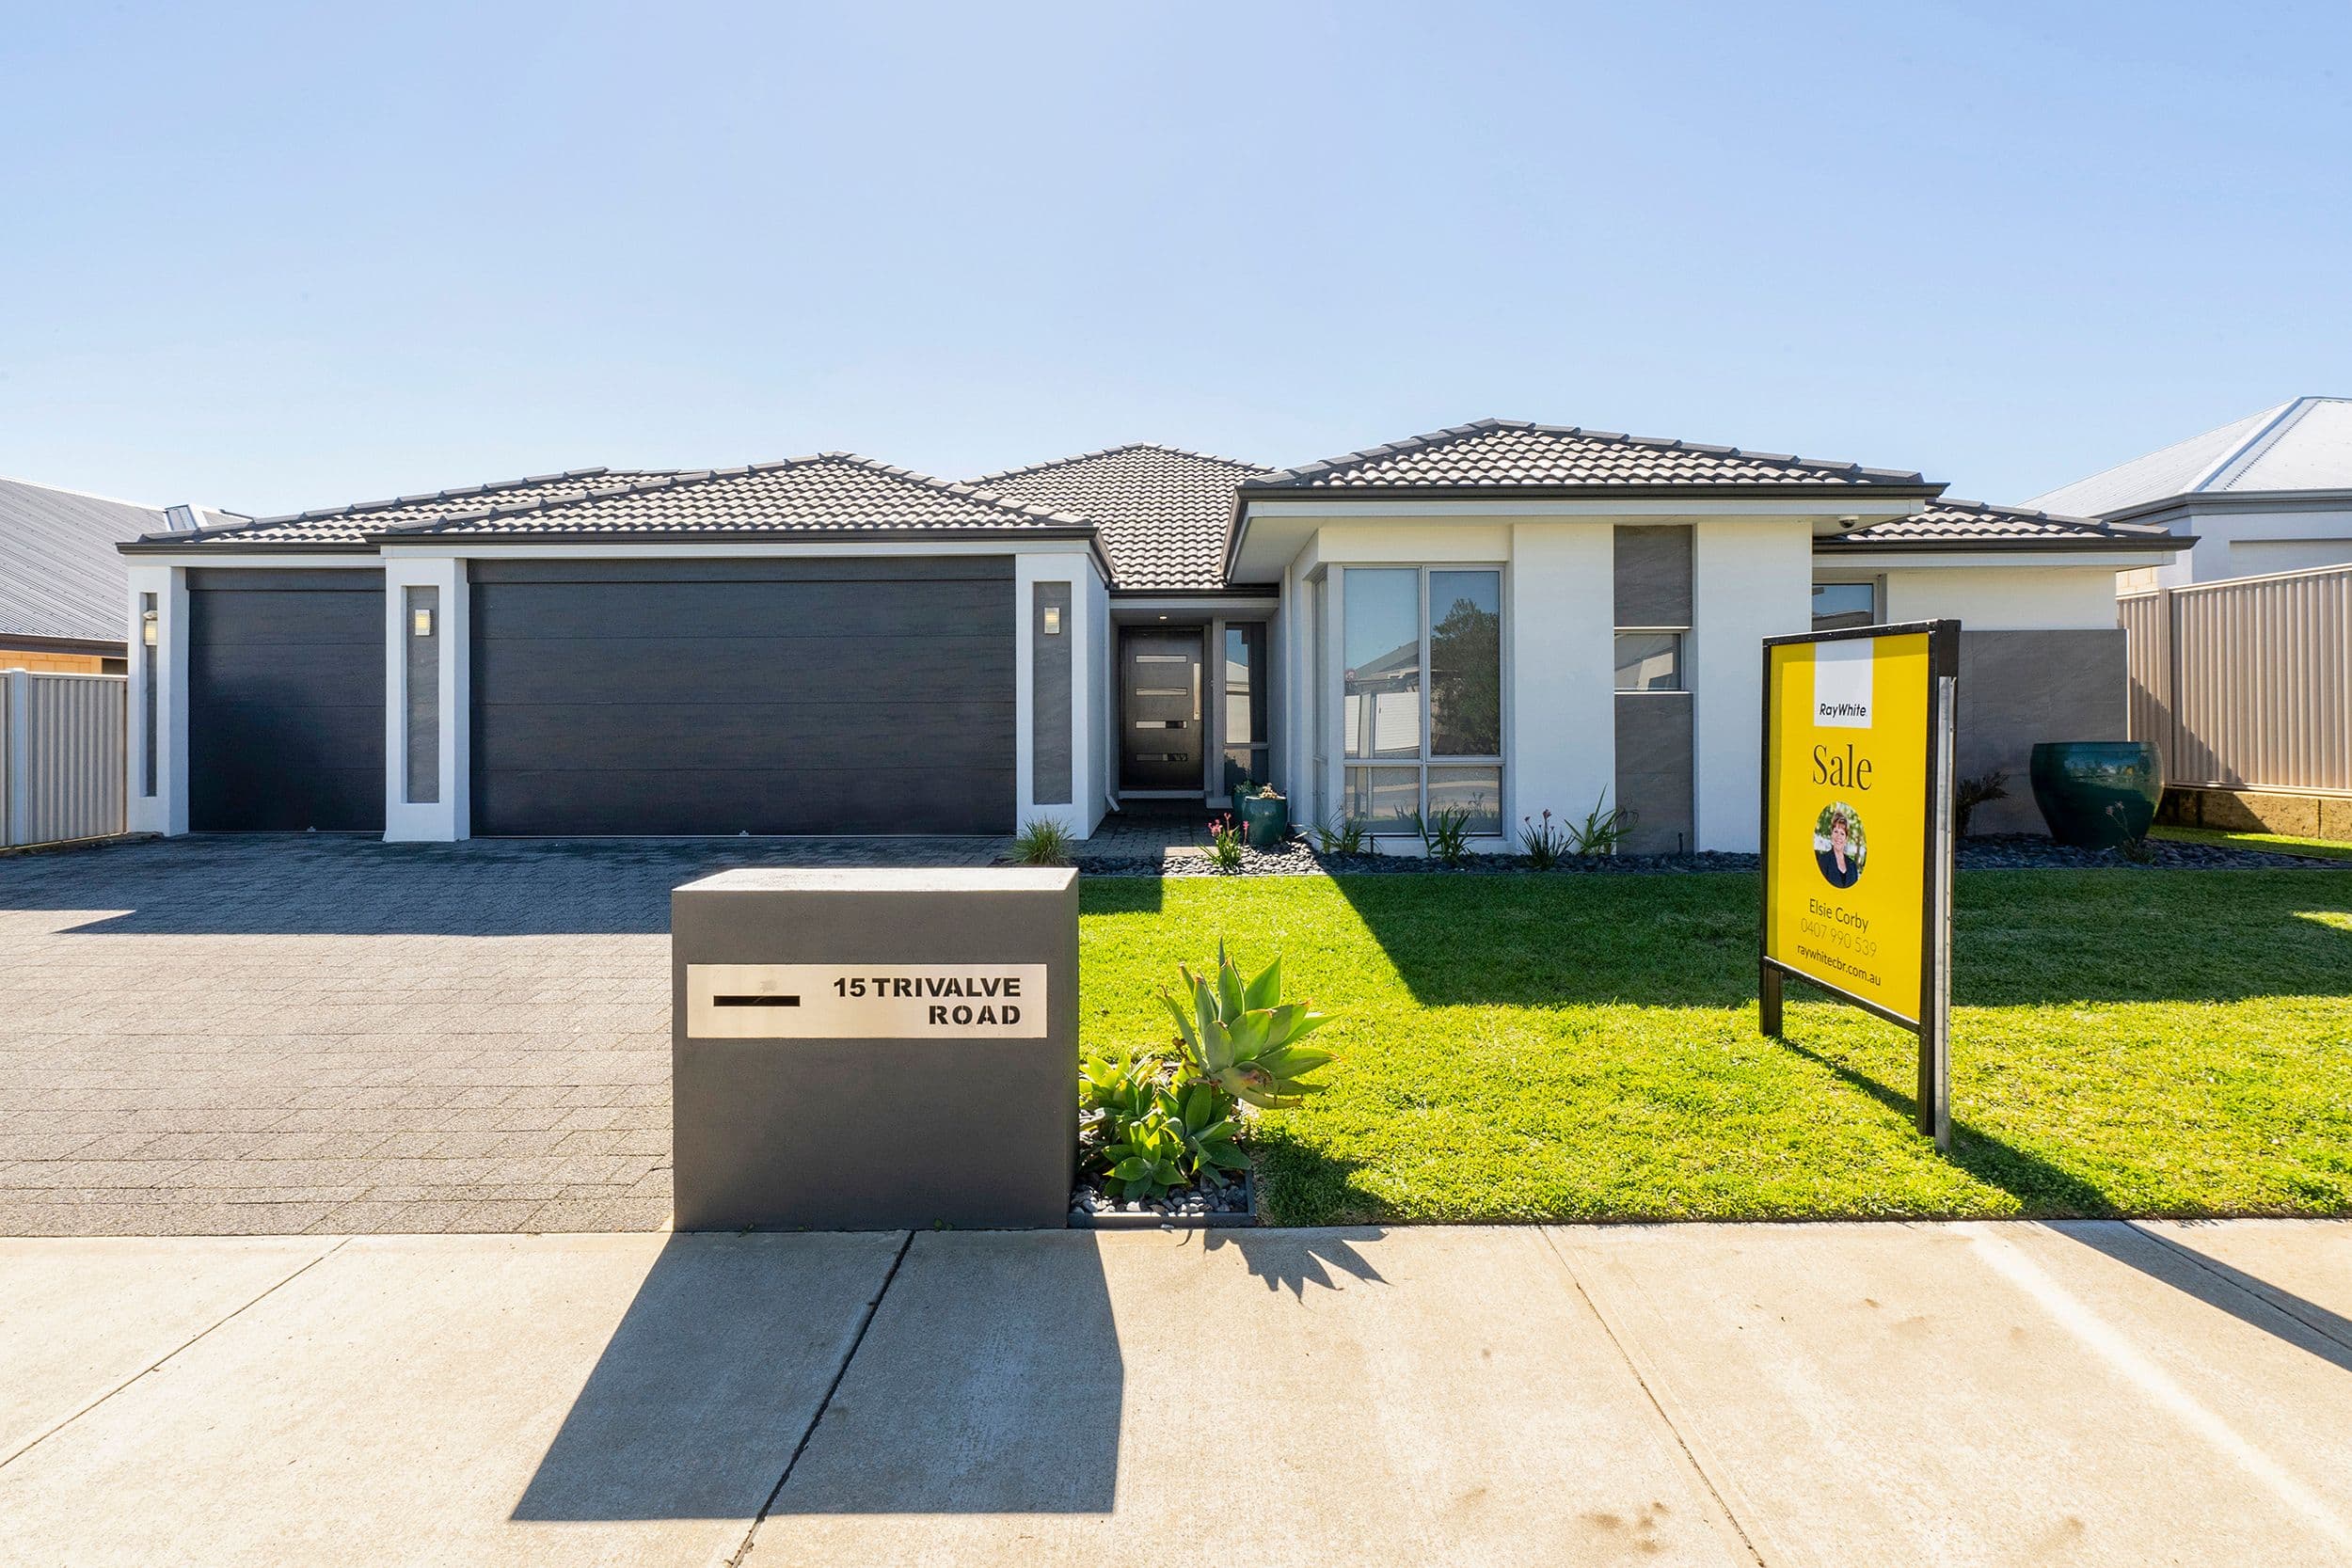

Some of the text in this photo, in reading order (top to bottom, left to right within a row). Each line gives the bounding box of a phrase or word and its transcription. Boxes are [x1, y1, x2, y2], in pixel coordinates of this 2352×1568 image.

[1813, 744, 1872, 790] Sale
[1809, 898, 1869, 933] Elsie Corby
[1801, 917, 1877, 958] 0407 990 539
[1797, 944, 1882, 987] raywhitecbr.com.au
[834, 977, 1021, 997] 15 TRIVALVE
[929, 1005, 1021, 1025] ROAD
